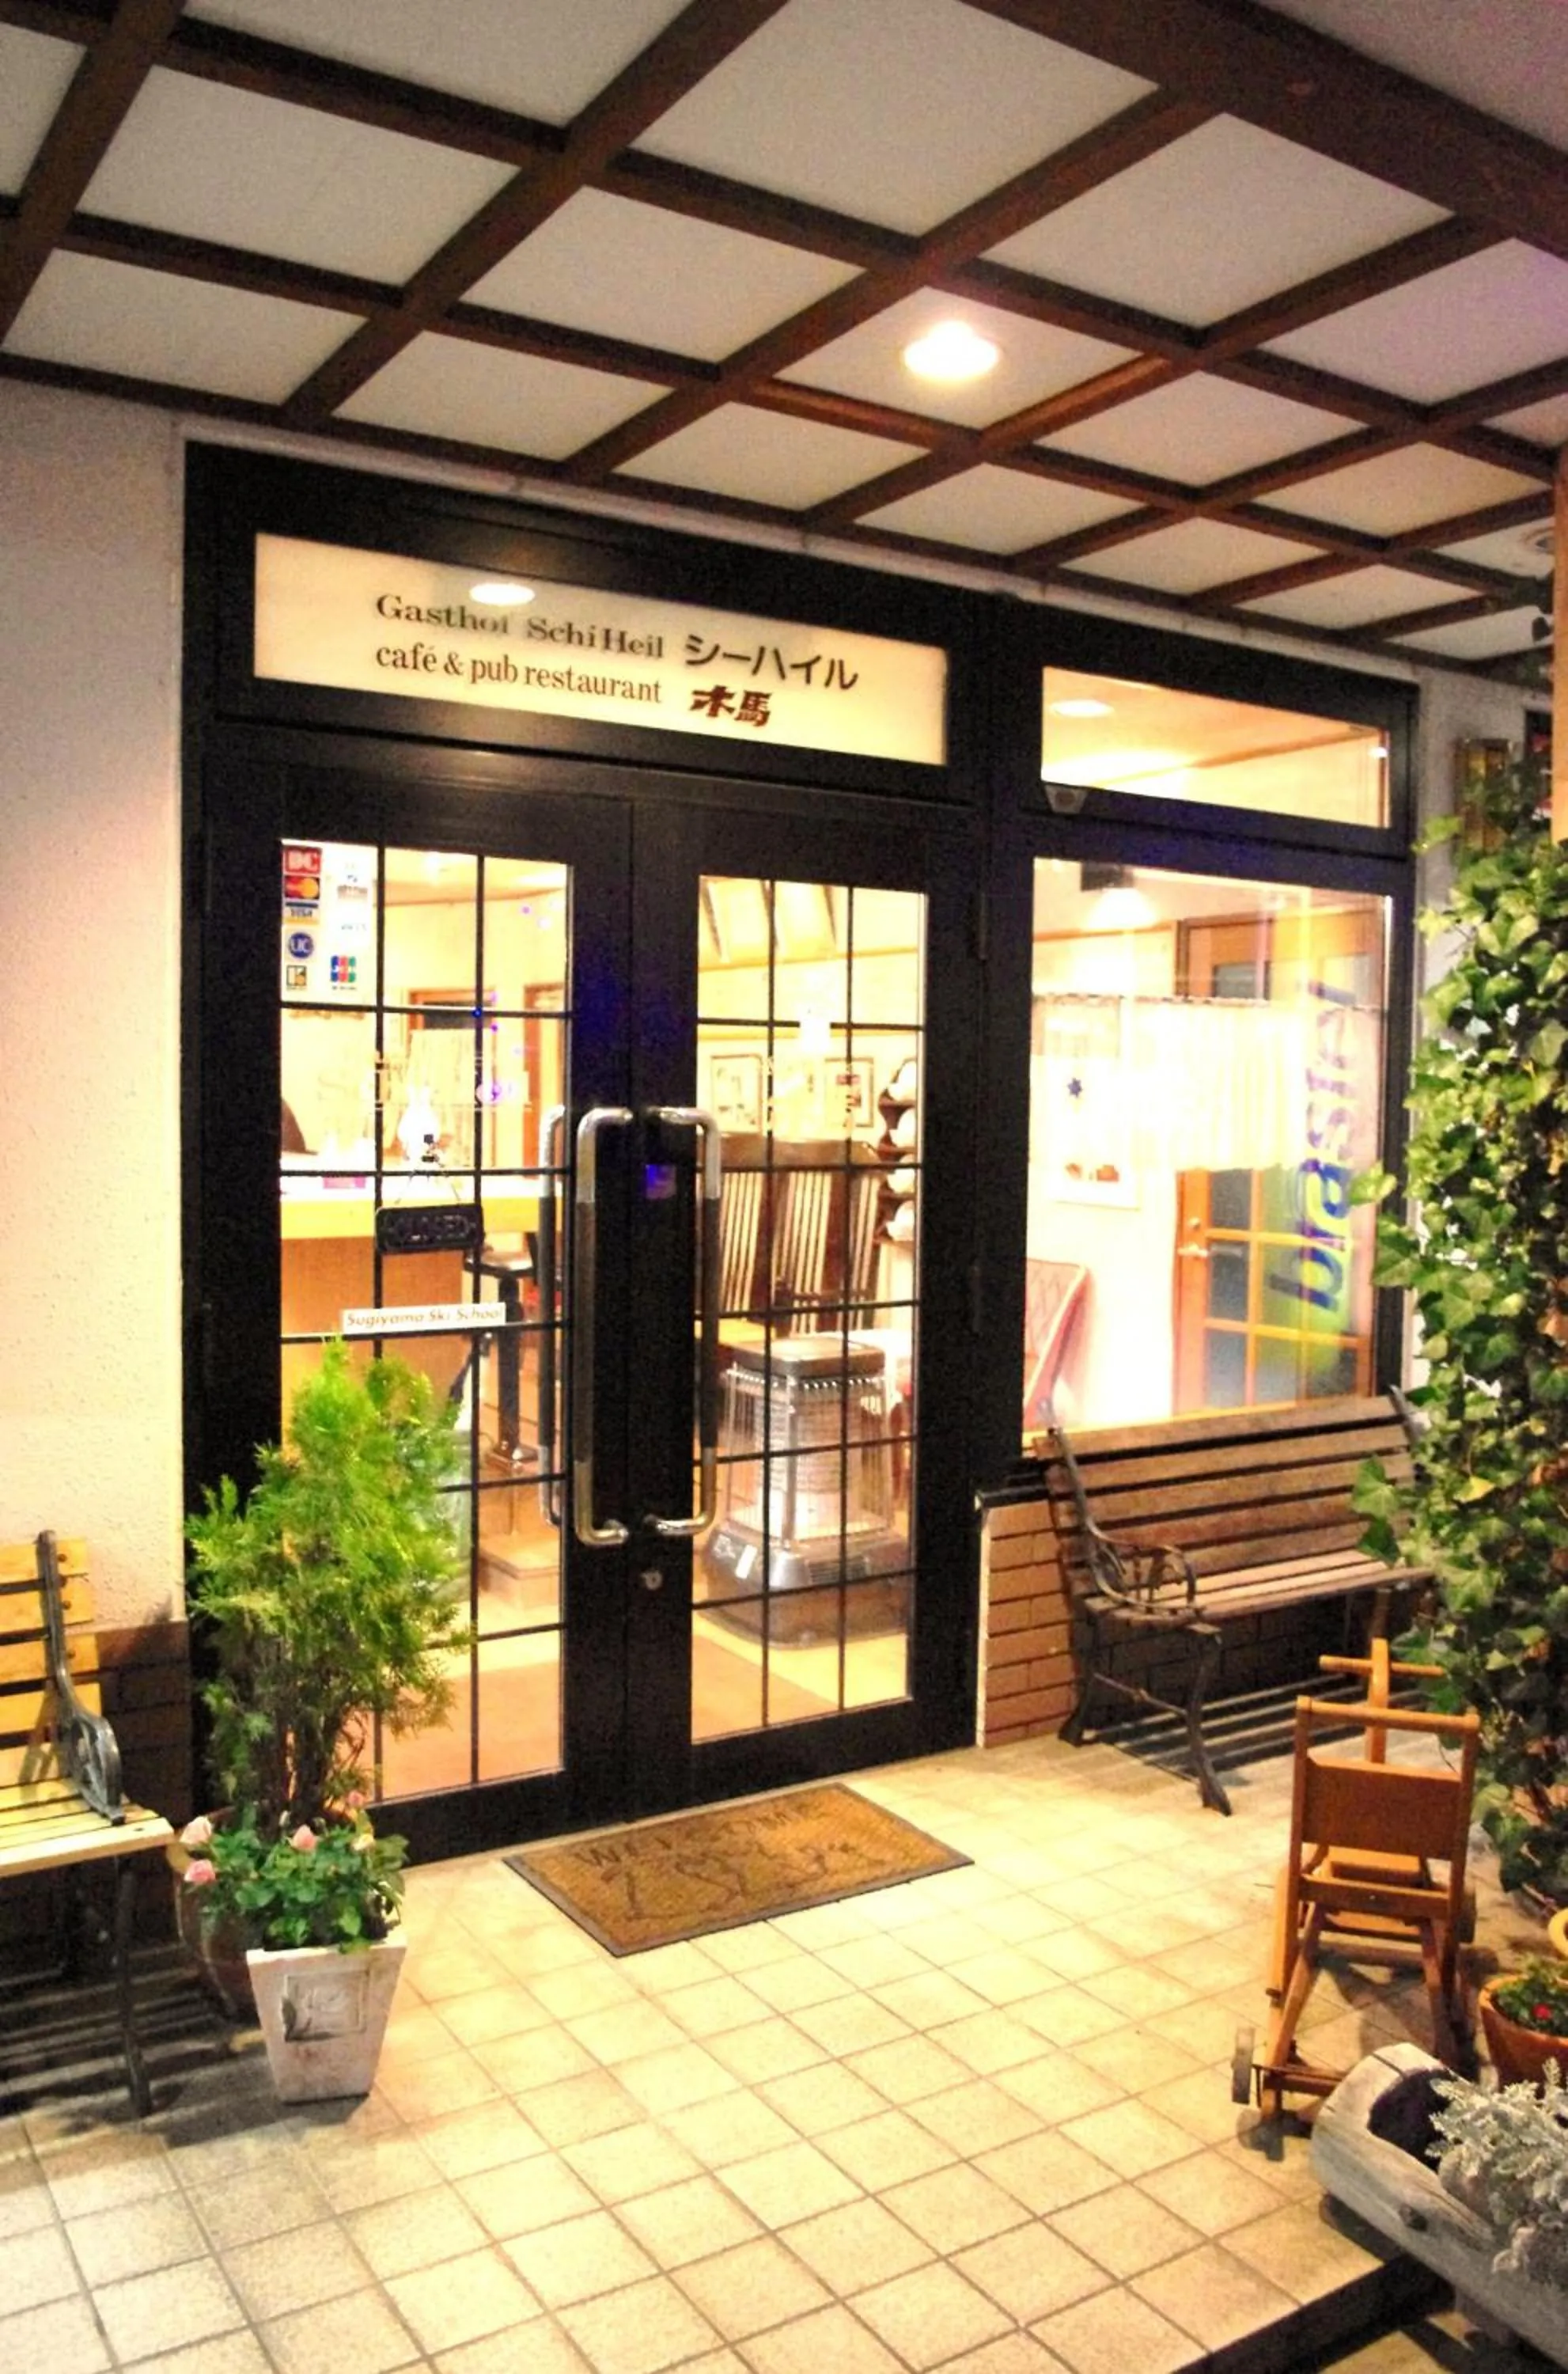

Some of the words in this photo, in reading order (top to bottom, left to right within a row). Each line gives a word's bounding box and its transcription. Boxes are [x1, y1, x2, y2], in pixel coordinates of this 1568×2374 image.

[376, 642, 438, 673] café
[443, 651, 464, 677] &
[469, 654, 519, 685] pub
[524, 665, 663, 703] restaurant
[685, 634, 859, 690] シーハイル
[689, 685, 773, 727] 木馬
